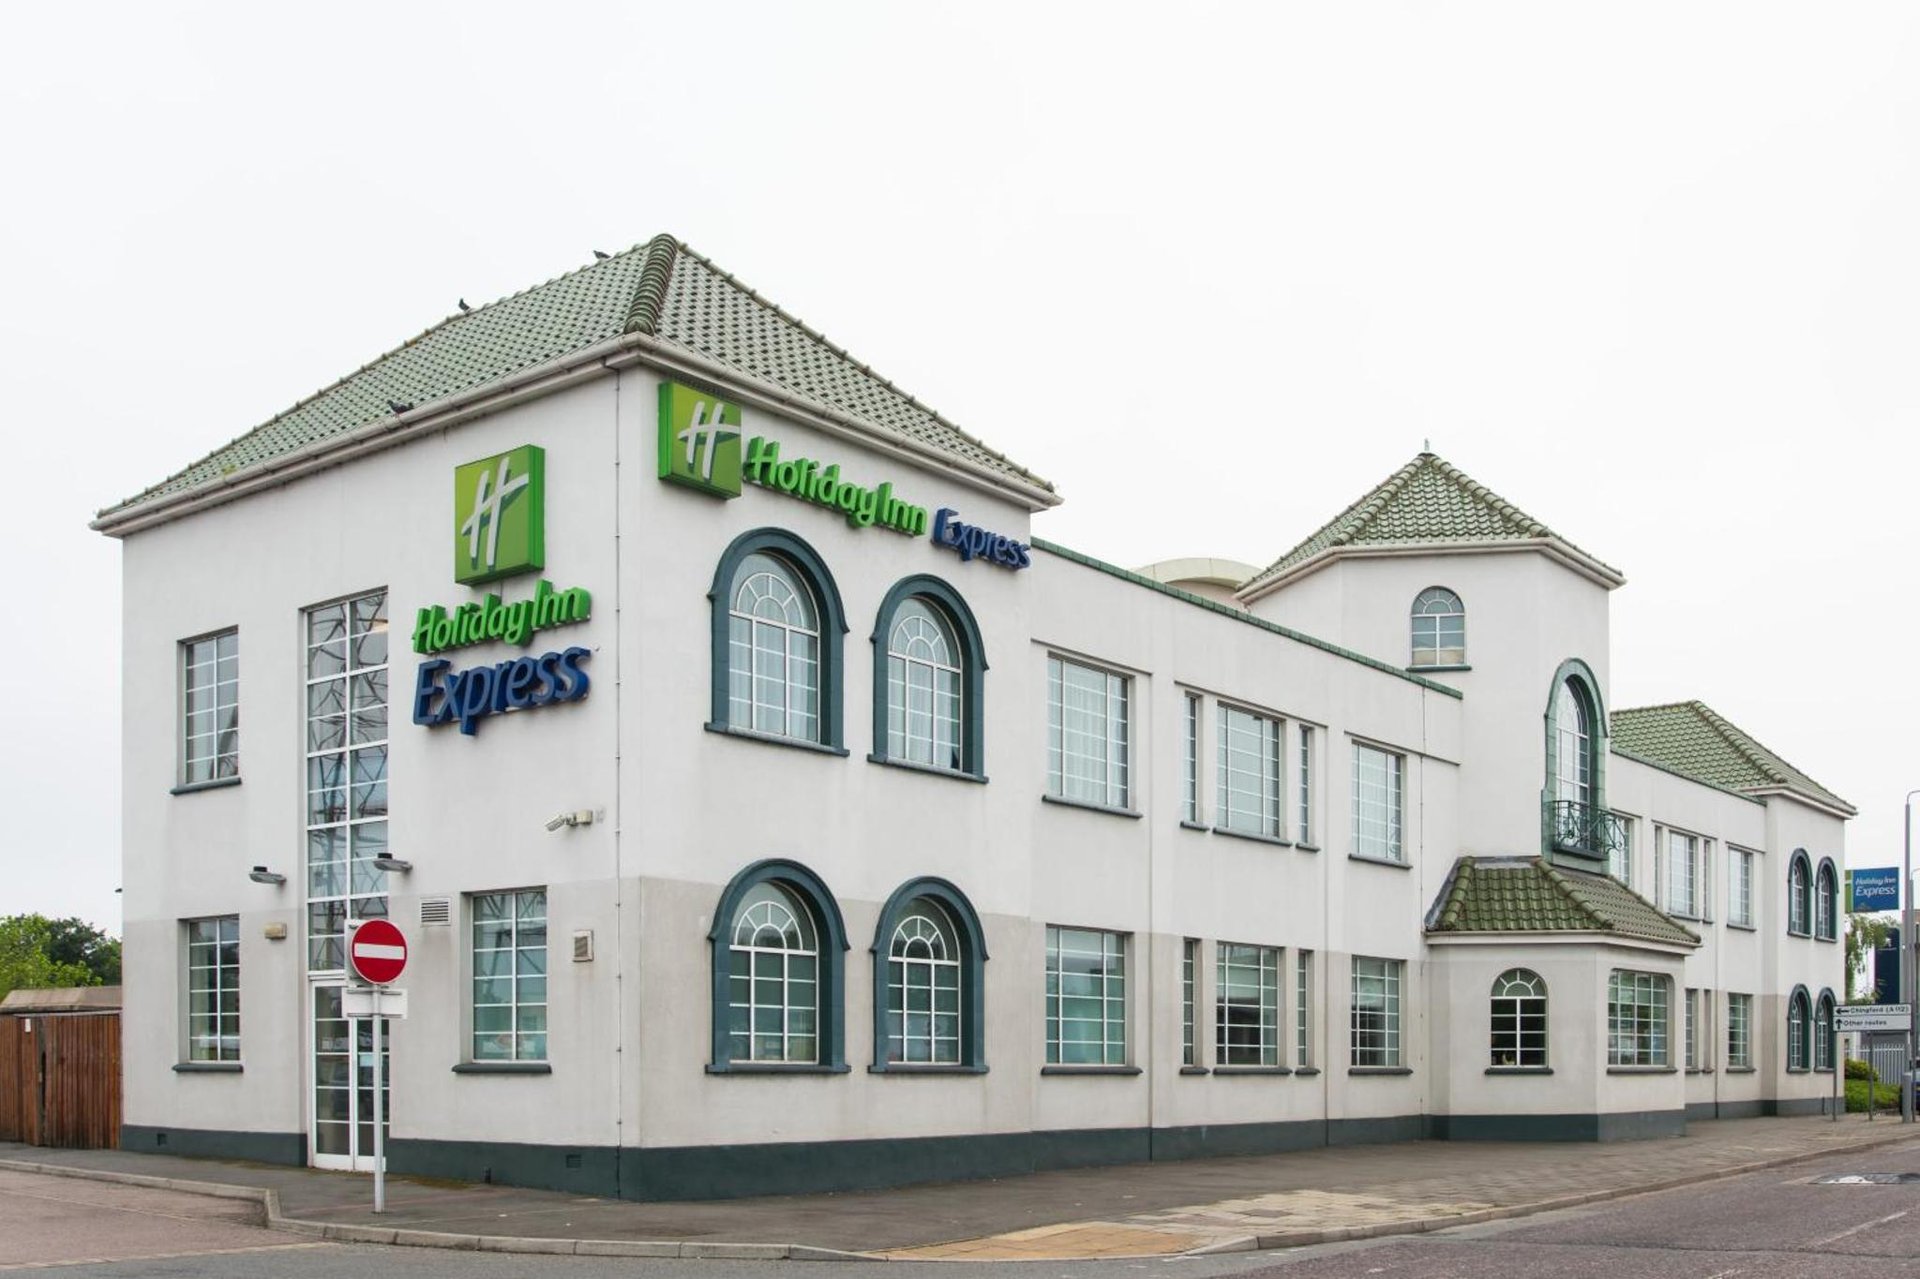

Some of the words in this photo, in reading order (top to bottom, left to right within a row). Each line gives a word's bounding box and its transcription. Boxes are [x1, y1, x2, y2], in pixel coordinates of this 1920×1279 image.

[743, 436, 877, 528] Holiday
[878, 482, 927, 536] Inn
[930, 508, 1031, 570] Express
[411, 593, 534, 654] Holiday
[531, 579, 591, 631] Inn
[413, 647, 591, 736] Express
[1856, 878, 1883, 886] Holiday
[1856, 886, 1896, 898] Express
